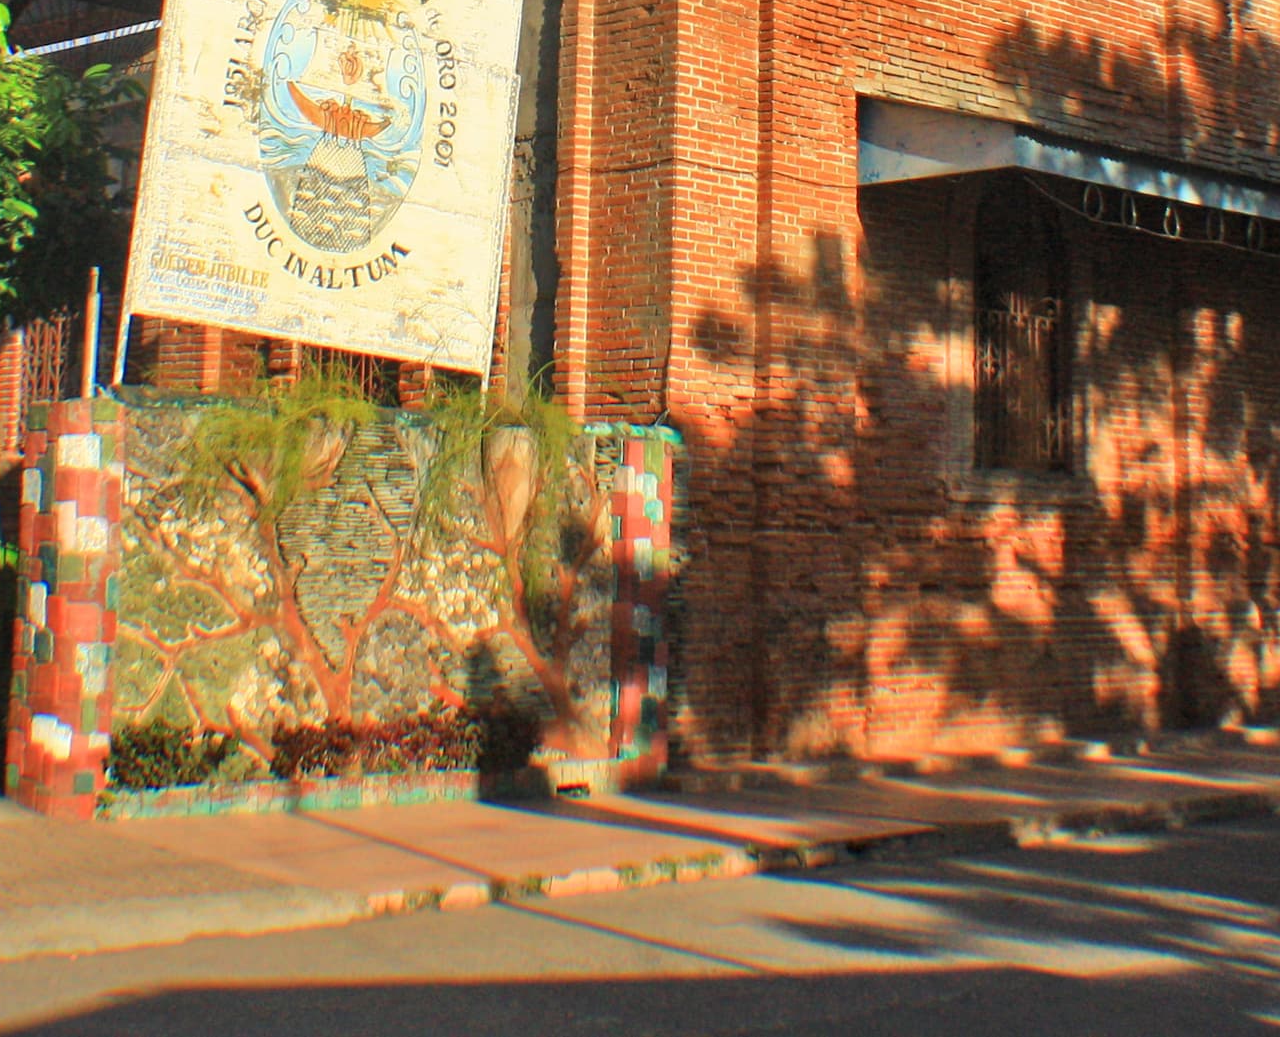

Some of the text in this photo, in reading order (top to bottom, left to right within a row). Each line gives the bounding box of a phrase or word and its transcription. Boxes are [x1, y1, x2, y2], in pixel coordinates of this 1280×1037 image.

[434, 40, 457, 90] ORO
[243, 202, 283, 258] DUC
[282, 251, 309, 279] IN
[309, 241, 412, 290] ALTUM
[207, 263, 270, 289] JUBILEE
